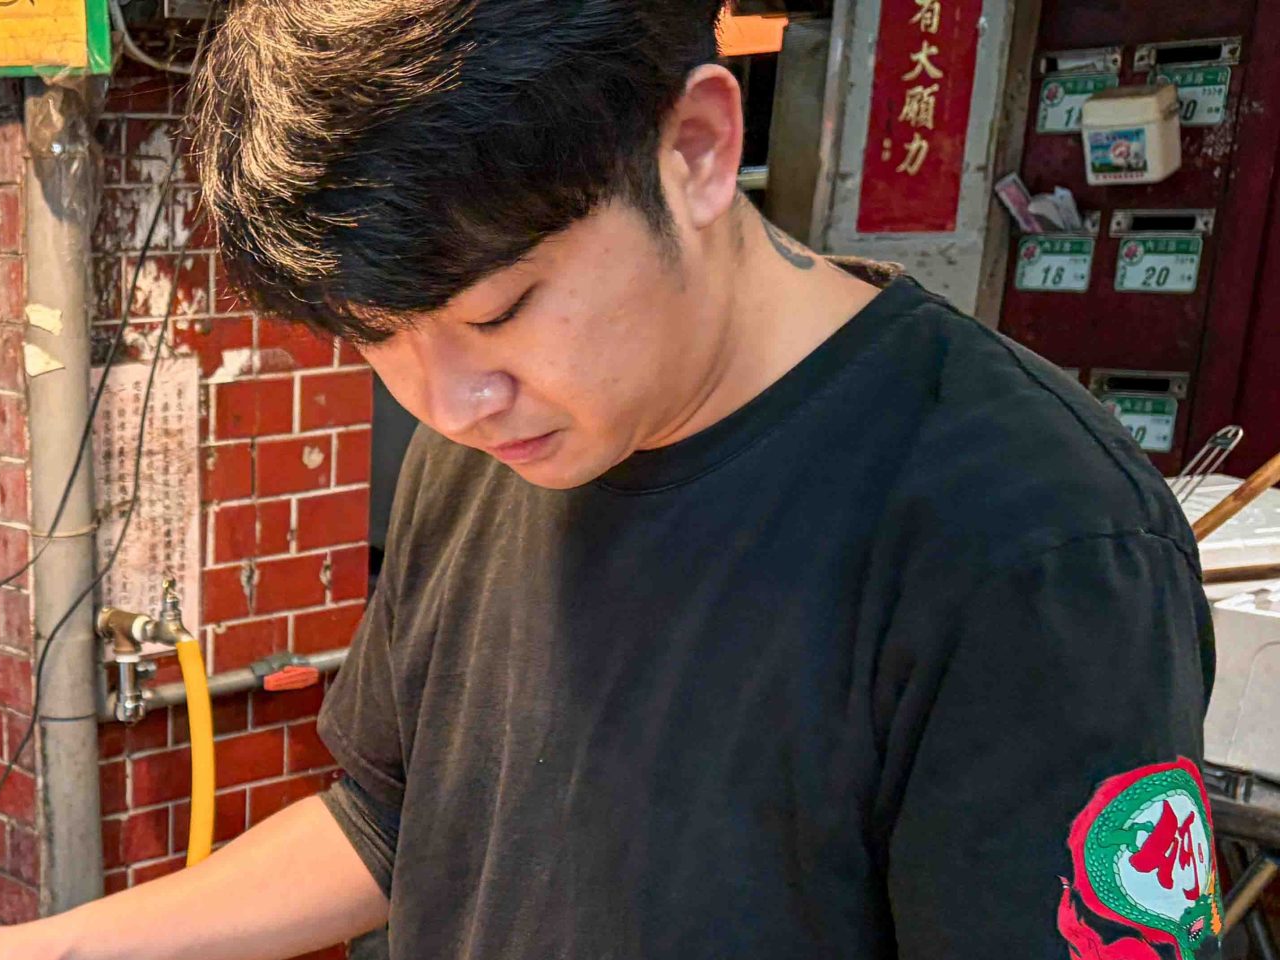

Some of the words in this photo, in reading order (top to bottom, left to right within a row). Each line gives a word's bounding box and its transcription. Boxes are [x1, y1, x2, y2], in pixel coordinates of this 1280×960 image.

[895, 0, 944, 177] 有大願力
[1142, 265, 1171, 288] 20
